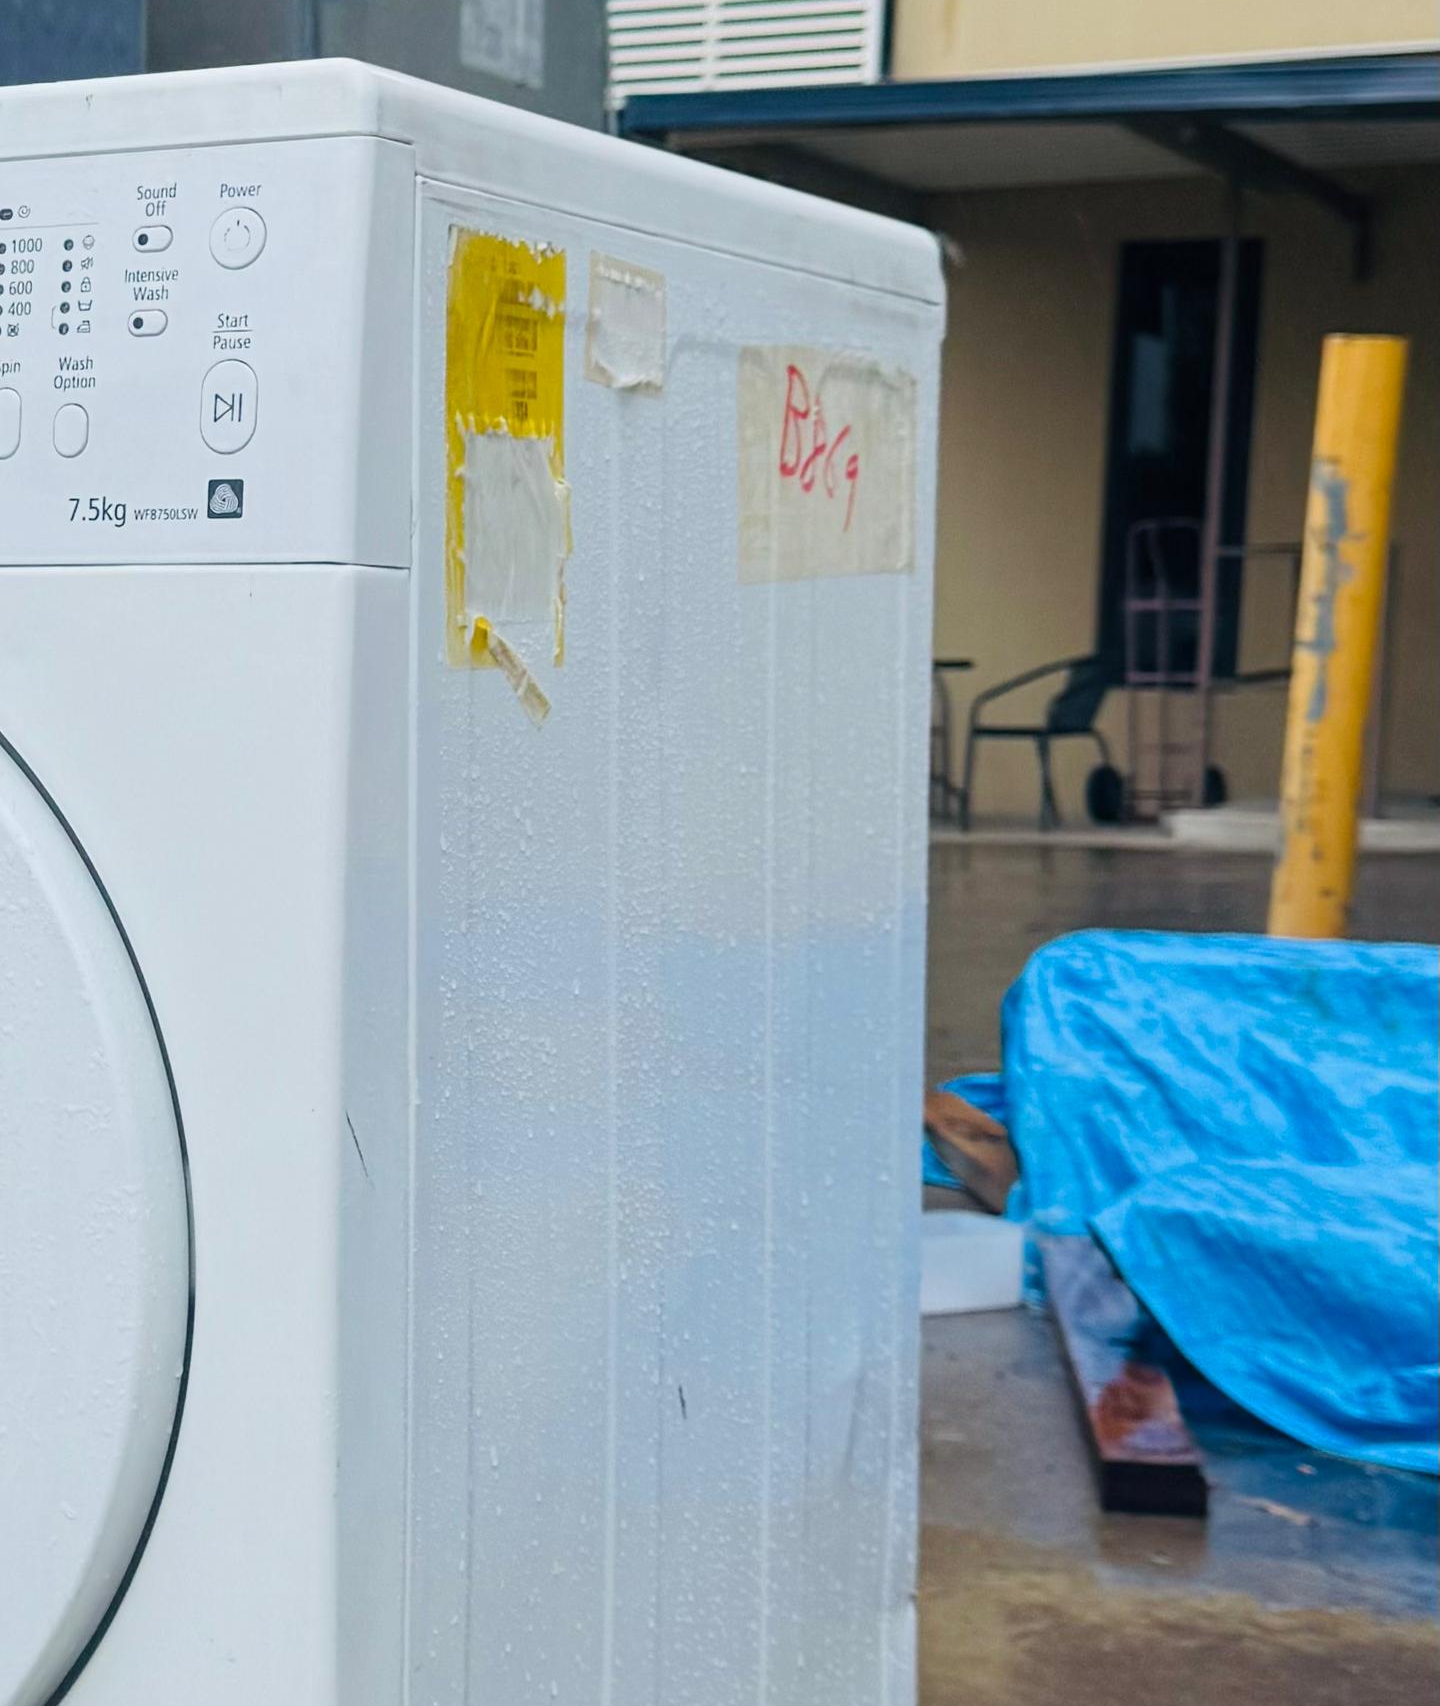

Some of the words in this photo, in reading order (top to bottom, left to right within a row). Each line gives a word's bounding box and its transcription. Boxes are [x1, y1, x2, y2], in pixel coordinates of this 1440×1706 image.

[137, 183, 177, 200] Sound
[220, 183, 262, 198] Power
[145, 200, 166, 217] Off
[12, 238, 42, 253] 1000
[11, 259, 34, 274] 800
[125, 268, 178, 282] Intensive
[9, 281, 32, 295] 600
[134, 285, 169, 301] Wash
[8, 302, 31, 316] 400
[218, 313, 248, 328] Start
[213, 335, 251, 350] Pause
[59, 356, 93, 371] Wash
[53, 375, 96, 392] Option
[68, 496, 127, 528] 7.5kg
[134, 508, 199, 521] WF8750LSW
